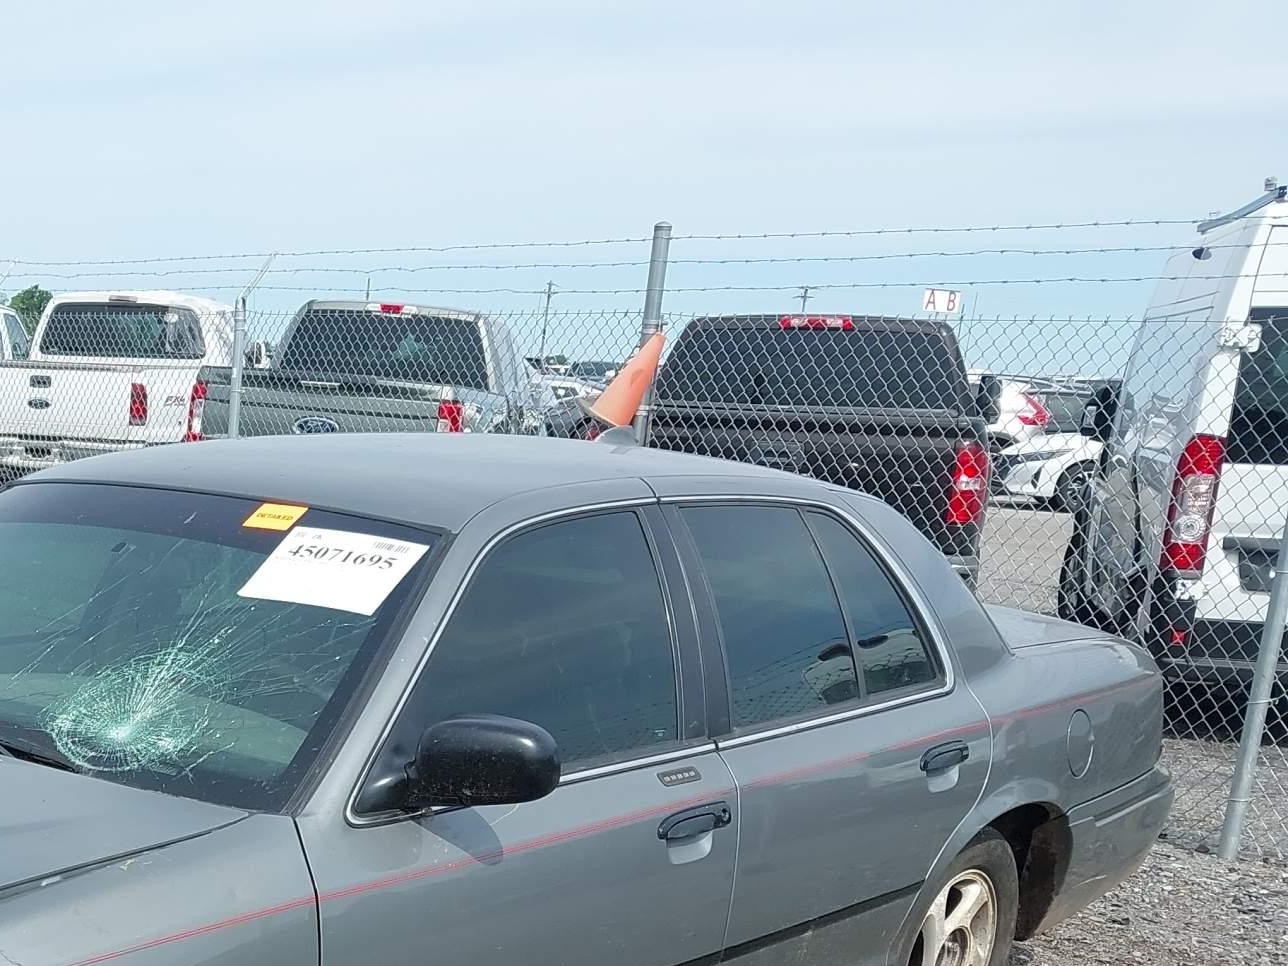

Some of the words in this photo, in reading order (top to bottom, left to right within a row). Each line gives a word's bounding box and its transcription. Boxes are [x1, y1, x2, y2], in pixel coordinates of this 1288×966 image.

[925, 289, 936, 310] A
[947, 291, 957, 311] B
[256, 512, 294, 521] DETAILED
[288, 544, 398, 570] 45071695
